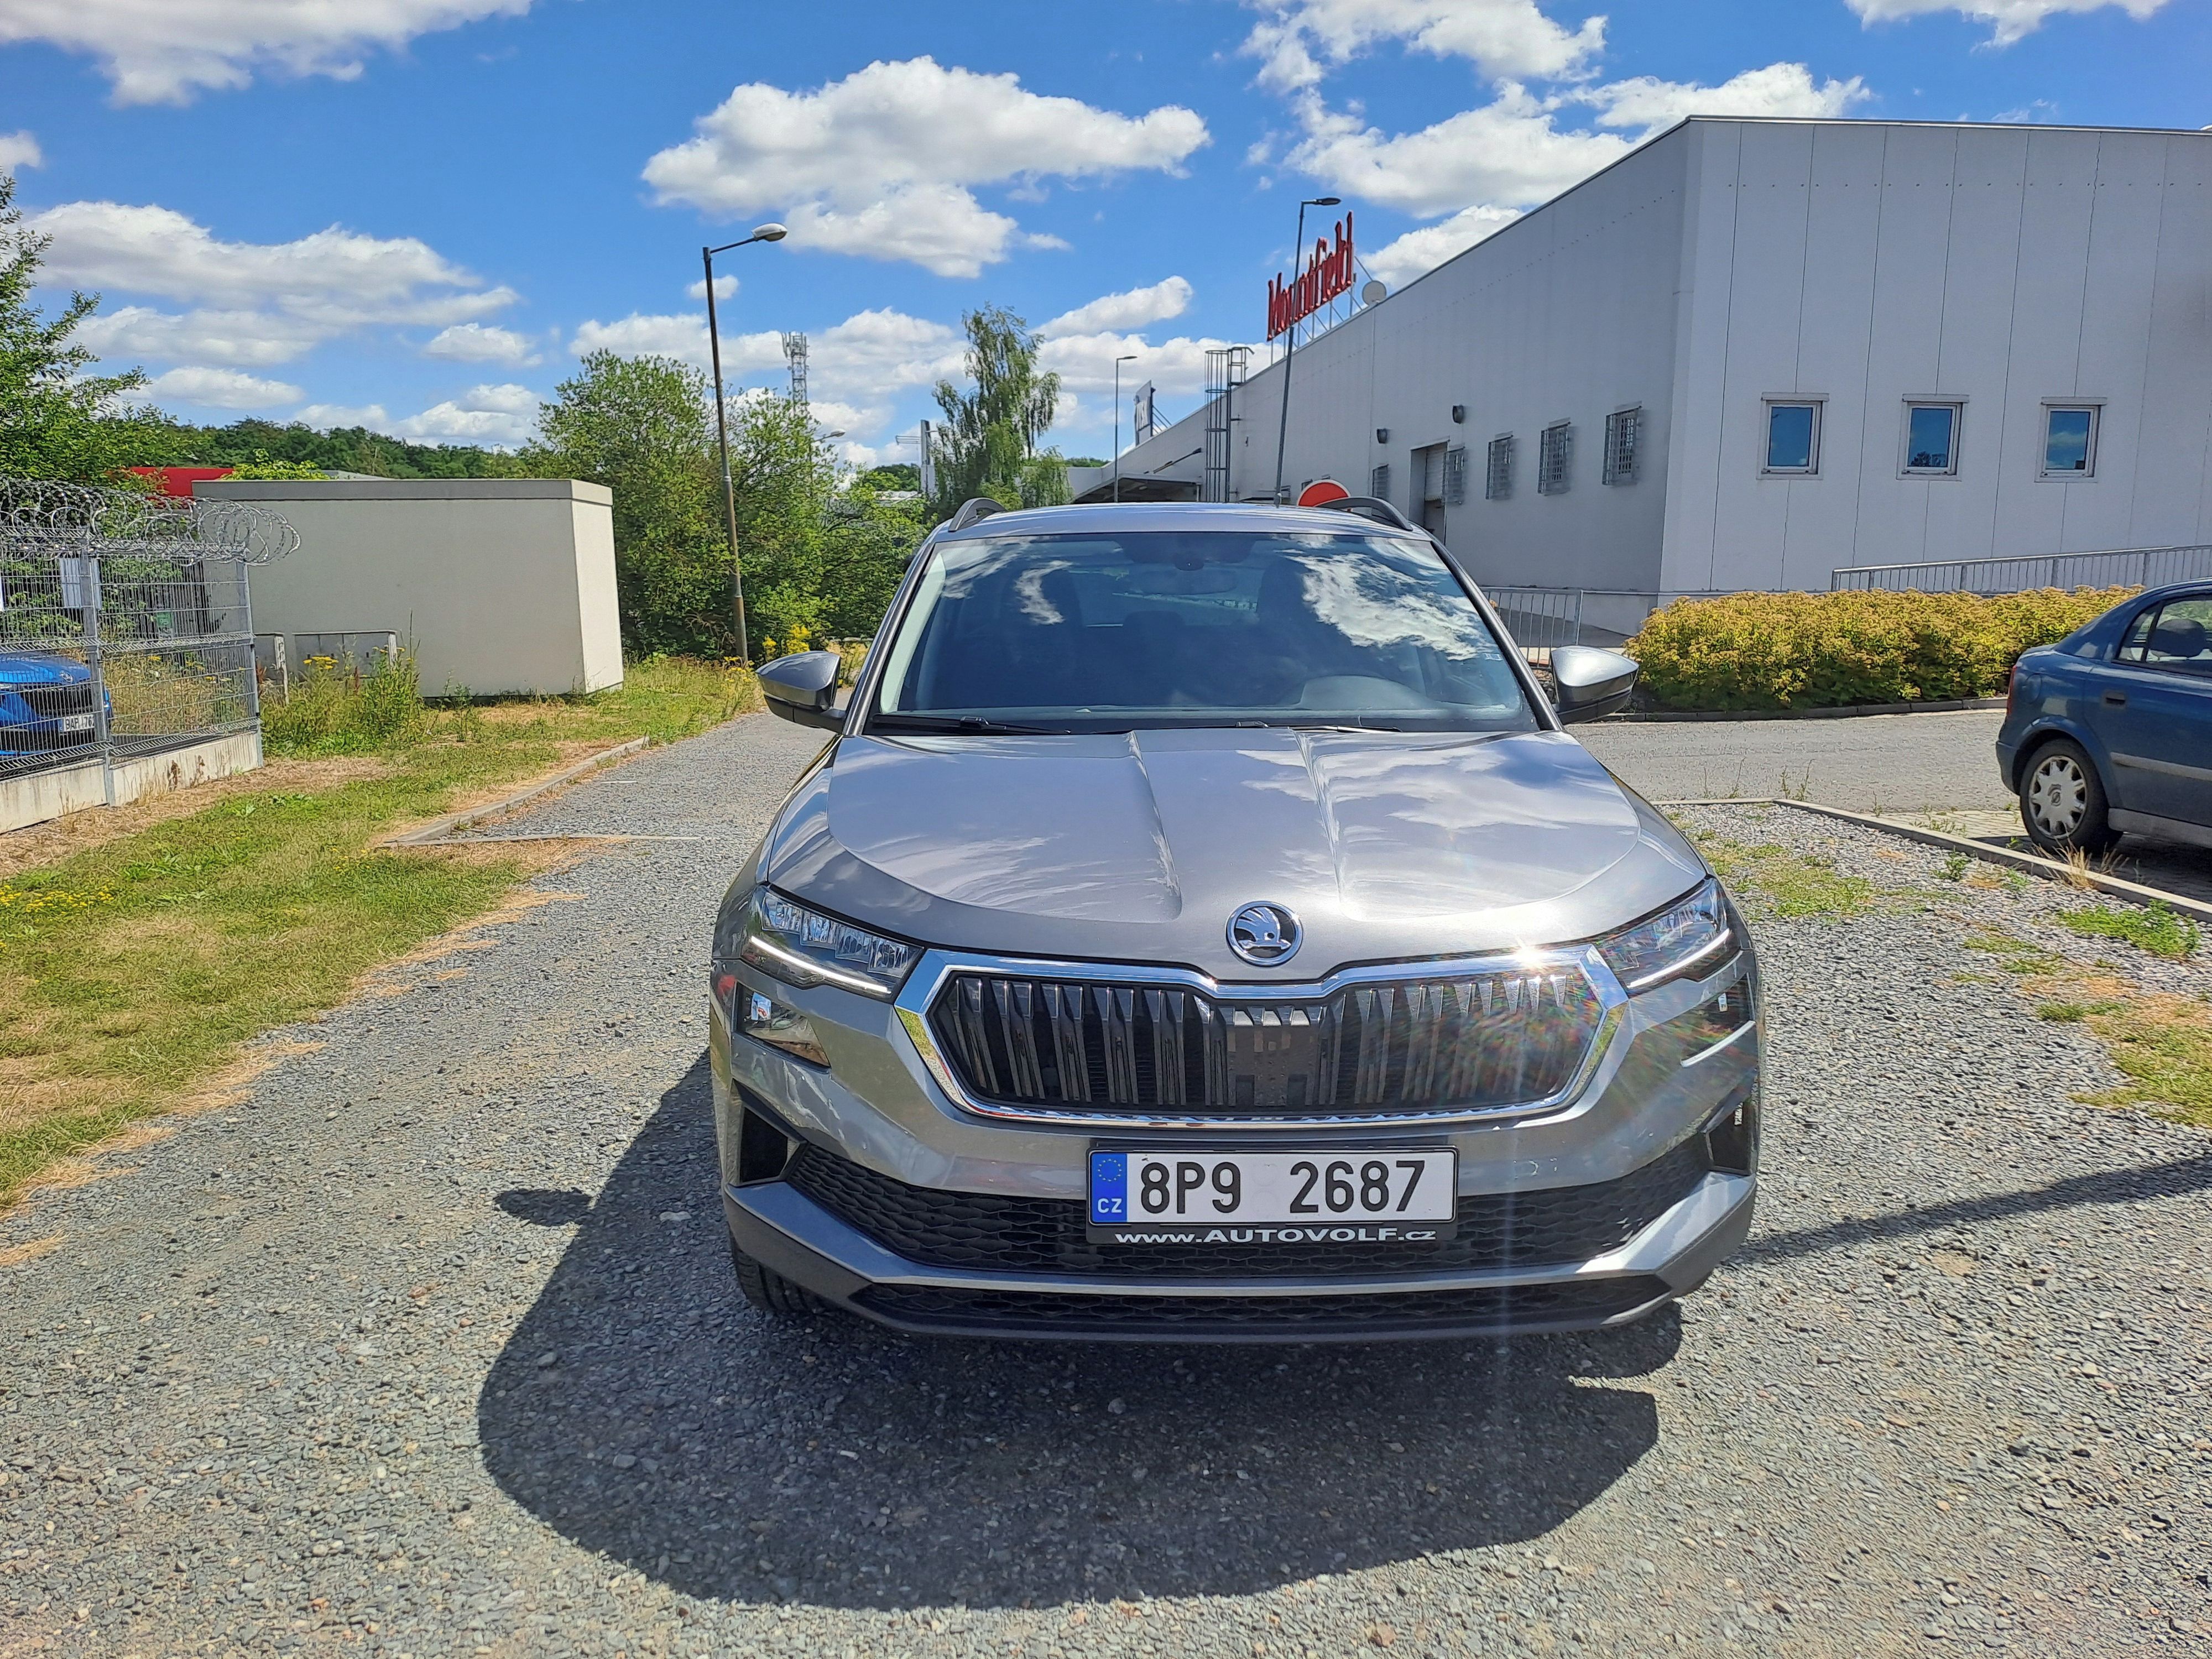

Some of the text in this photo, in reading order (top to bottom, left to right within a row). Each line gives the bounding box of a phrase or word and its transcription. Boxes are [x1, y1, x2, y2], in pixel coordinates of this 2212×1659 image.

[1267, 211, 1353, 341] Mountfield
[1141, 1160, 1426, 1214] 8P9 2687
[1098, 1198, 1122, 1213] CZ
[1115, 1228, 1436, 1243] www.AUTOVOLF.cz
